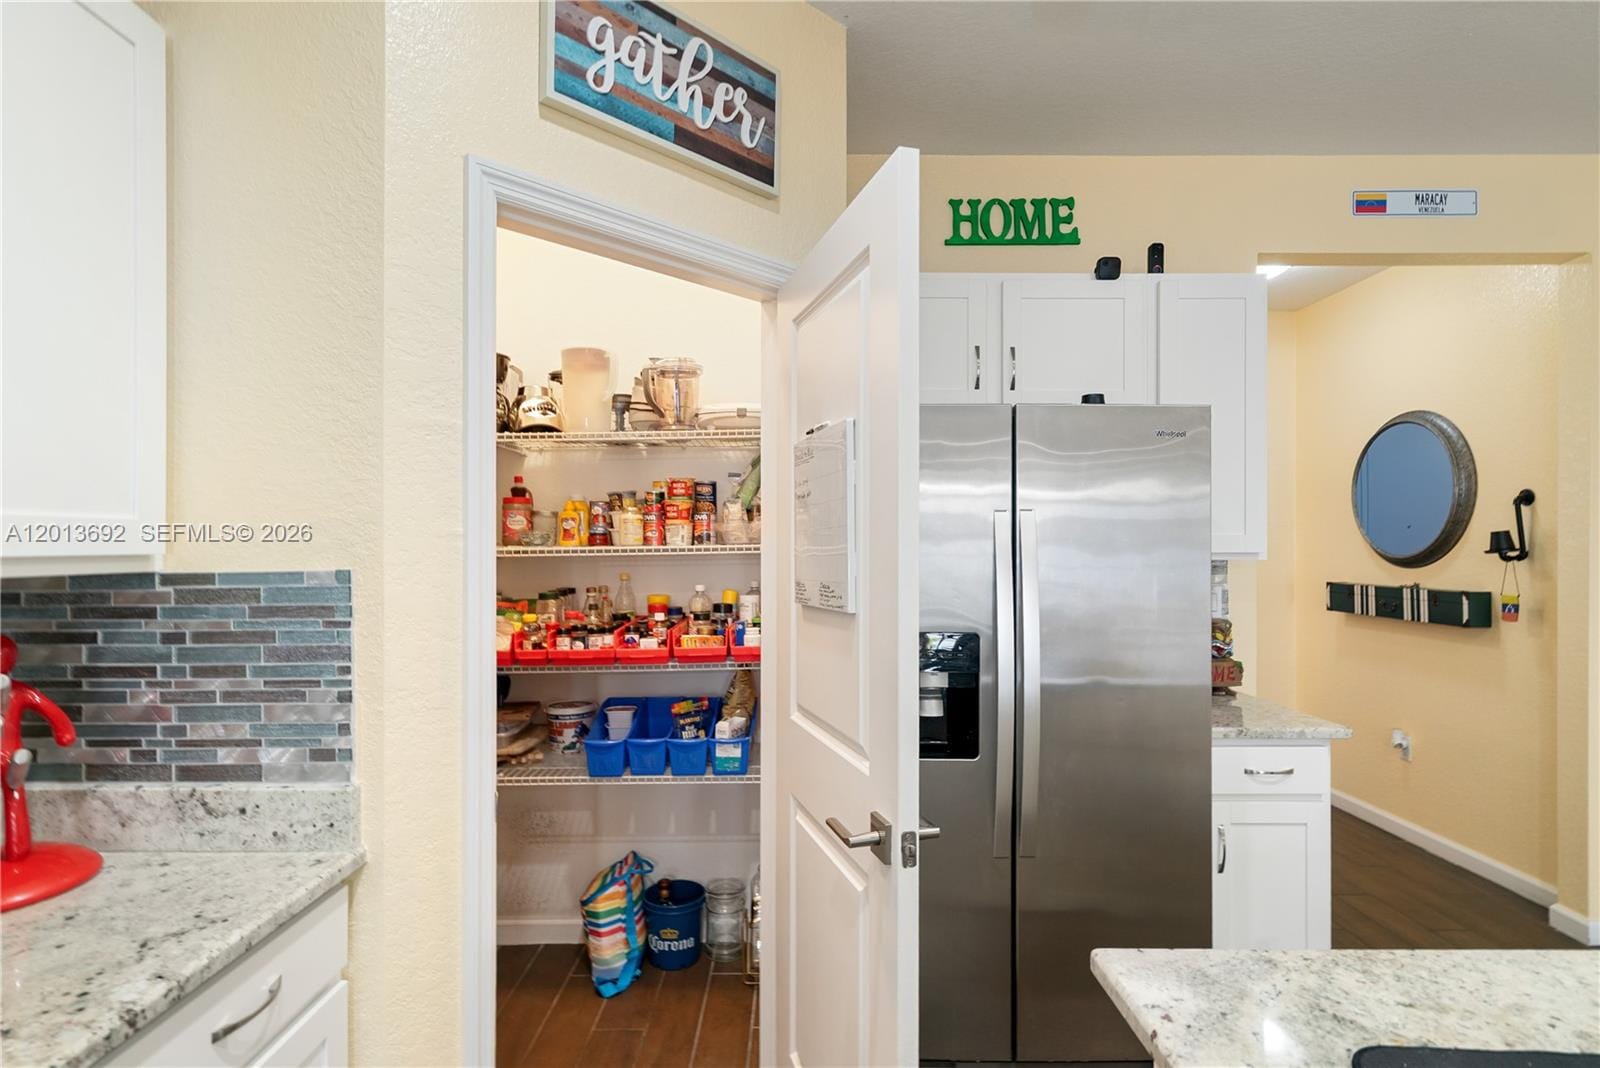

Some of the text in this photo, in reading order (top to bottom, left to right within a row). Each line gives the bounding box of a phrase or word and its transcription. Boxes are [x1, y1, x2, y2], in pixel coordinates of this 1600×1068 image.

[586, 16, 765, 149] gather
[1414, 193, 1448, 206] MARACAY
[947, 196, 1079, 242] HOME
[648, 933, 695, 953] Corona
